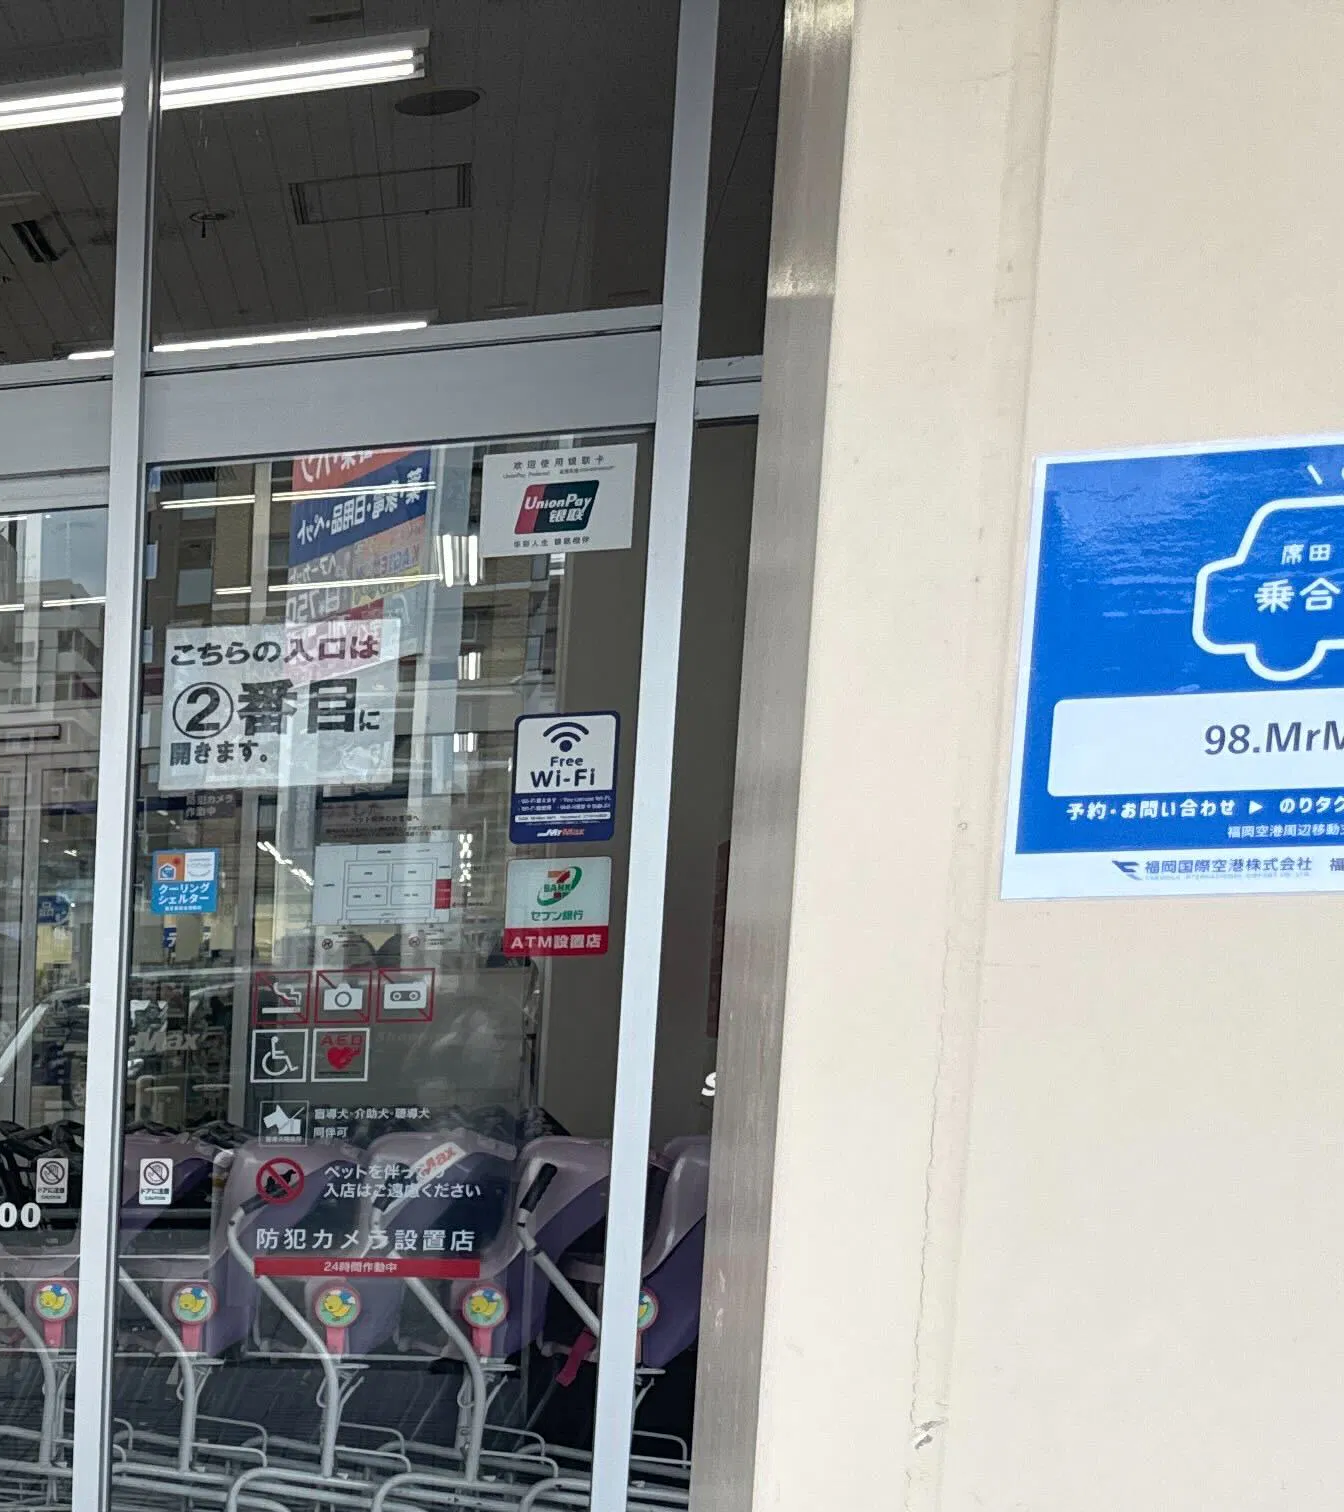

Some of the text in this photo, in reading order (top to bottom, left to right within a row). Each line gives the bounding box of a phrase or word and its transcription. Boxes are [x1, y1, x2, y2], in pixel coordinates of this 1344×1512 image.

[524, 493, 593, 512] UnionPay
[1280, 543, 1332, 566] 席田
[1254, 577, 1341, 614] 乗合
[170, 635, 381, 667] こちらの入口は
[169, 739, 268, 767] 開きます。
[550, 756, 584, 768] Free
[530, 768, 596, 788] Wi-Fi
[1065, 798, 1236, 822] 予約・お問い合わせ
[1227, 822, 1344, 839] 福岡空港周辺移動
[1145, 856, 1312, 874] 福岡国際空港株式会社
[158, 883, 210, 895] クーリング
[158, 895, 210, 905] シェルター
[530, 909, 584, 922] セブン銀行
[510, 933, 603, 950] ATM設置店
[320, 1034, 364, 1047] AED
[324, 1182, 482, 1199] 入店はご遠慮ください
[256, 1227, 476, 1253] 防犯カメラ設置店
[323, 1261, 397, 1273] 24時間作動中
